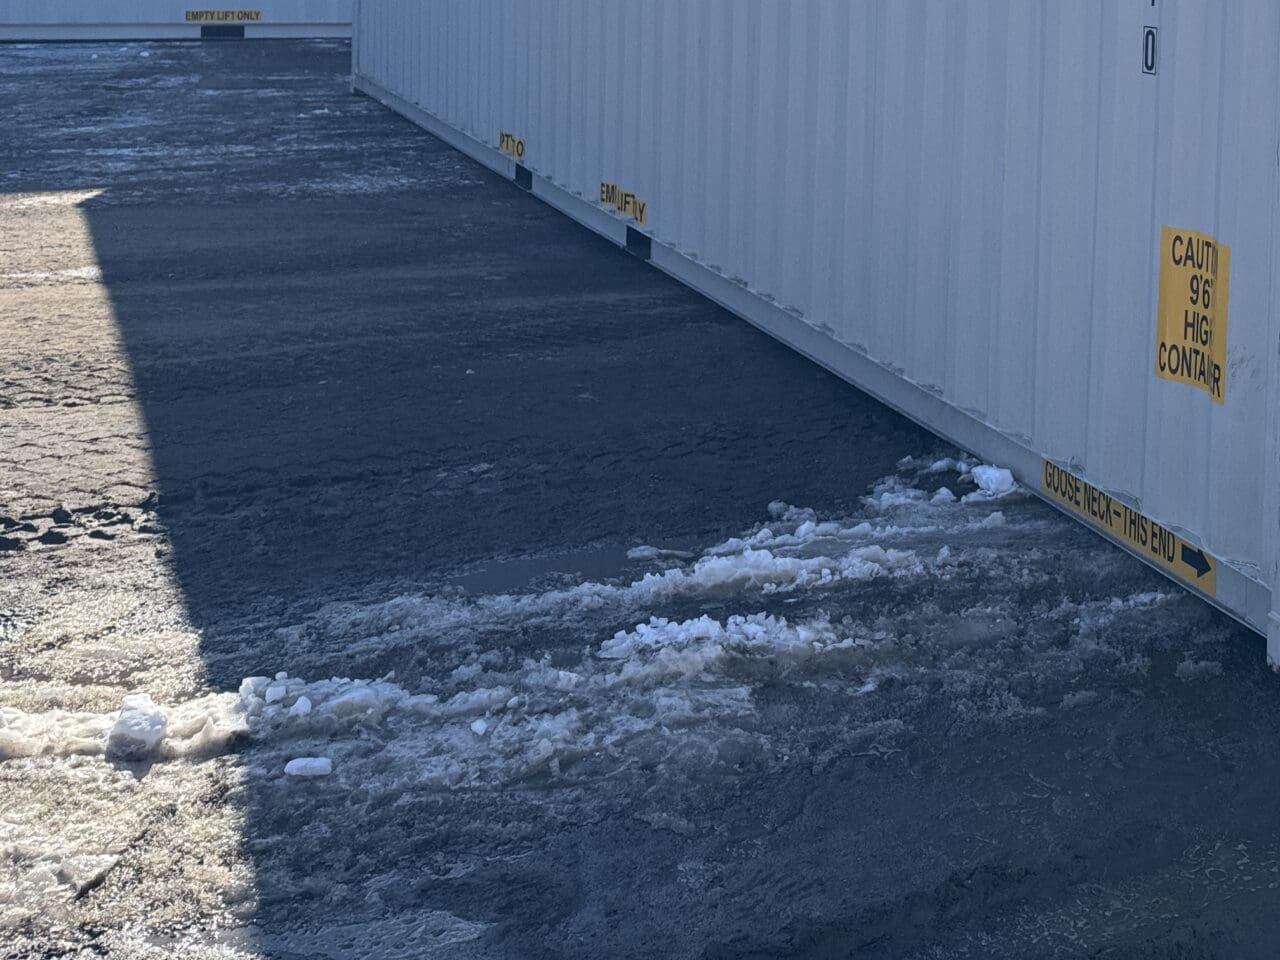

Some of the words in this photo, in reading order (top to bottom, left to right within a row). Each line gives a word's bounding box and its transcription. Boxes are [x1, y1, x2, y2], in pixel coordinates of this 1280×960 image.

[185, 10, 215, 20] EMPTY
[216, 10, 236, 20] LIFT
[237, 10, 260, 20] ONLY
[1044, 460, 1081, 508] GOOSE
[1151, 522, 1176, 563] END
